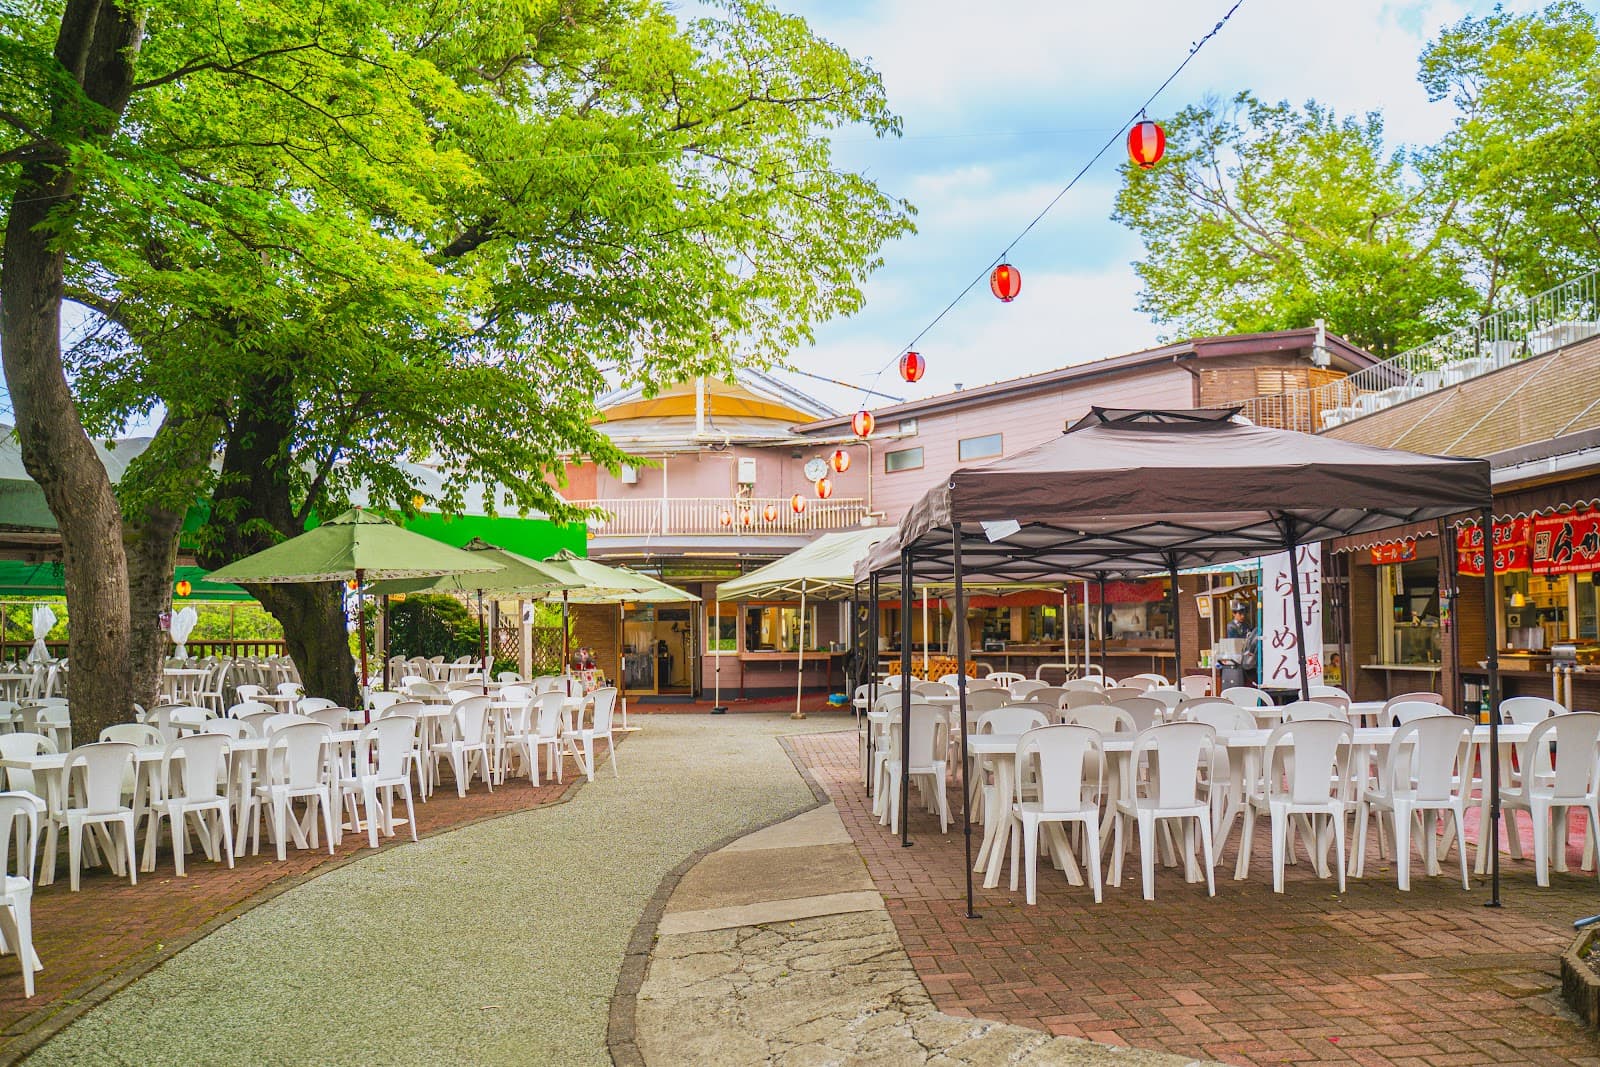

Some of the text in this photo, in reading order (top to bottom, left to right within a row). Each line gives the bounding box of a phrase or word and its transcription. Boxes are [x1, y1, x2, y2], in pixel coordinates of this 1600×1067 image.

[1472, 522, 1515, 545] 焼そば
[1297, 545, 1319, 626] 八王子
[1473, 549, 1515, 571] やとり
[1272, 571, 1298, 680] らーめん
